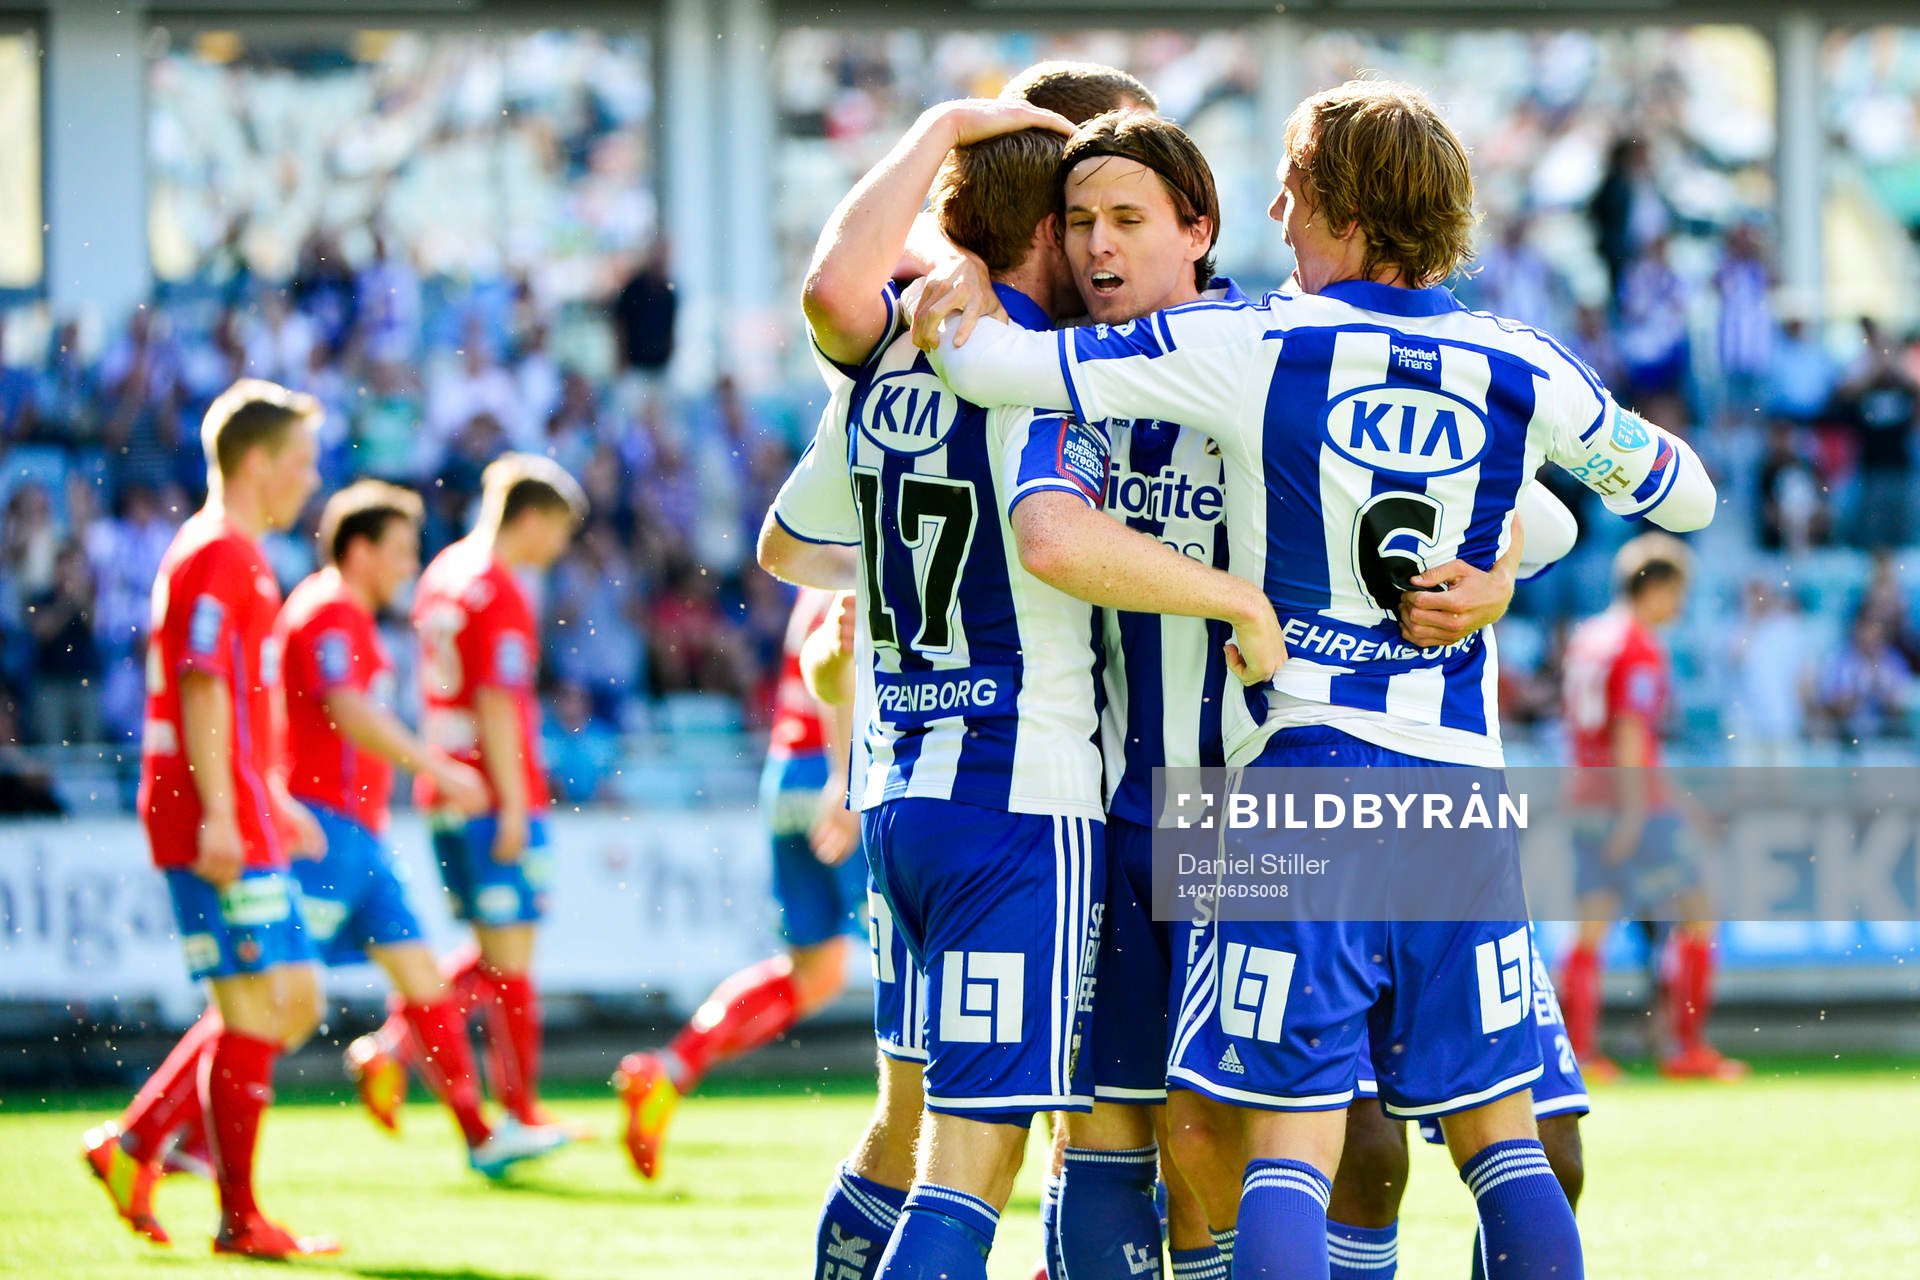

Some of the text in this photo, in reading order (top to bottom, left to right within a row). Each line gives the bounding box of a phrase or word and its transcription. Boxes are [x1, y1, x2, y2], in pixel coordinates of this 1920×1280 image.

[1391, 344, 1438, 361] Prioritet
[1398, 354, 1433, 371] Finans
[871, 383, 941, 439] KIA
[1349, 400, 1464, 461] KIA
[1108, 462, 1227, 522] iorite
[851, 465, 978, 653] 17
[1351, 490, 1445, 619] 6
[1218, 1061, 1245, 1075] adidas
